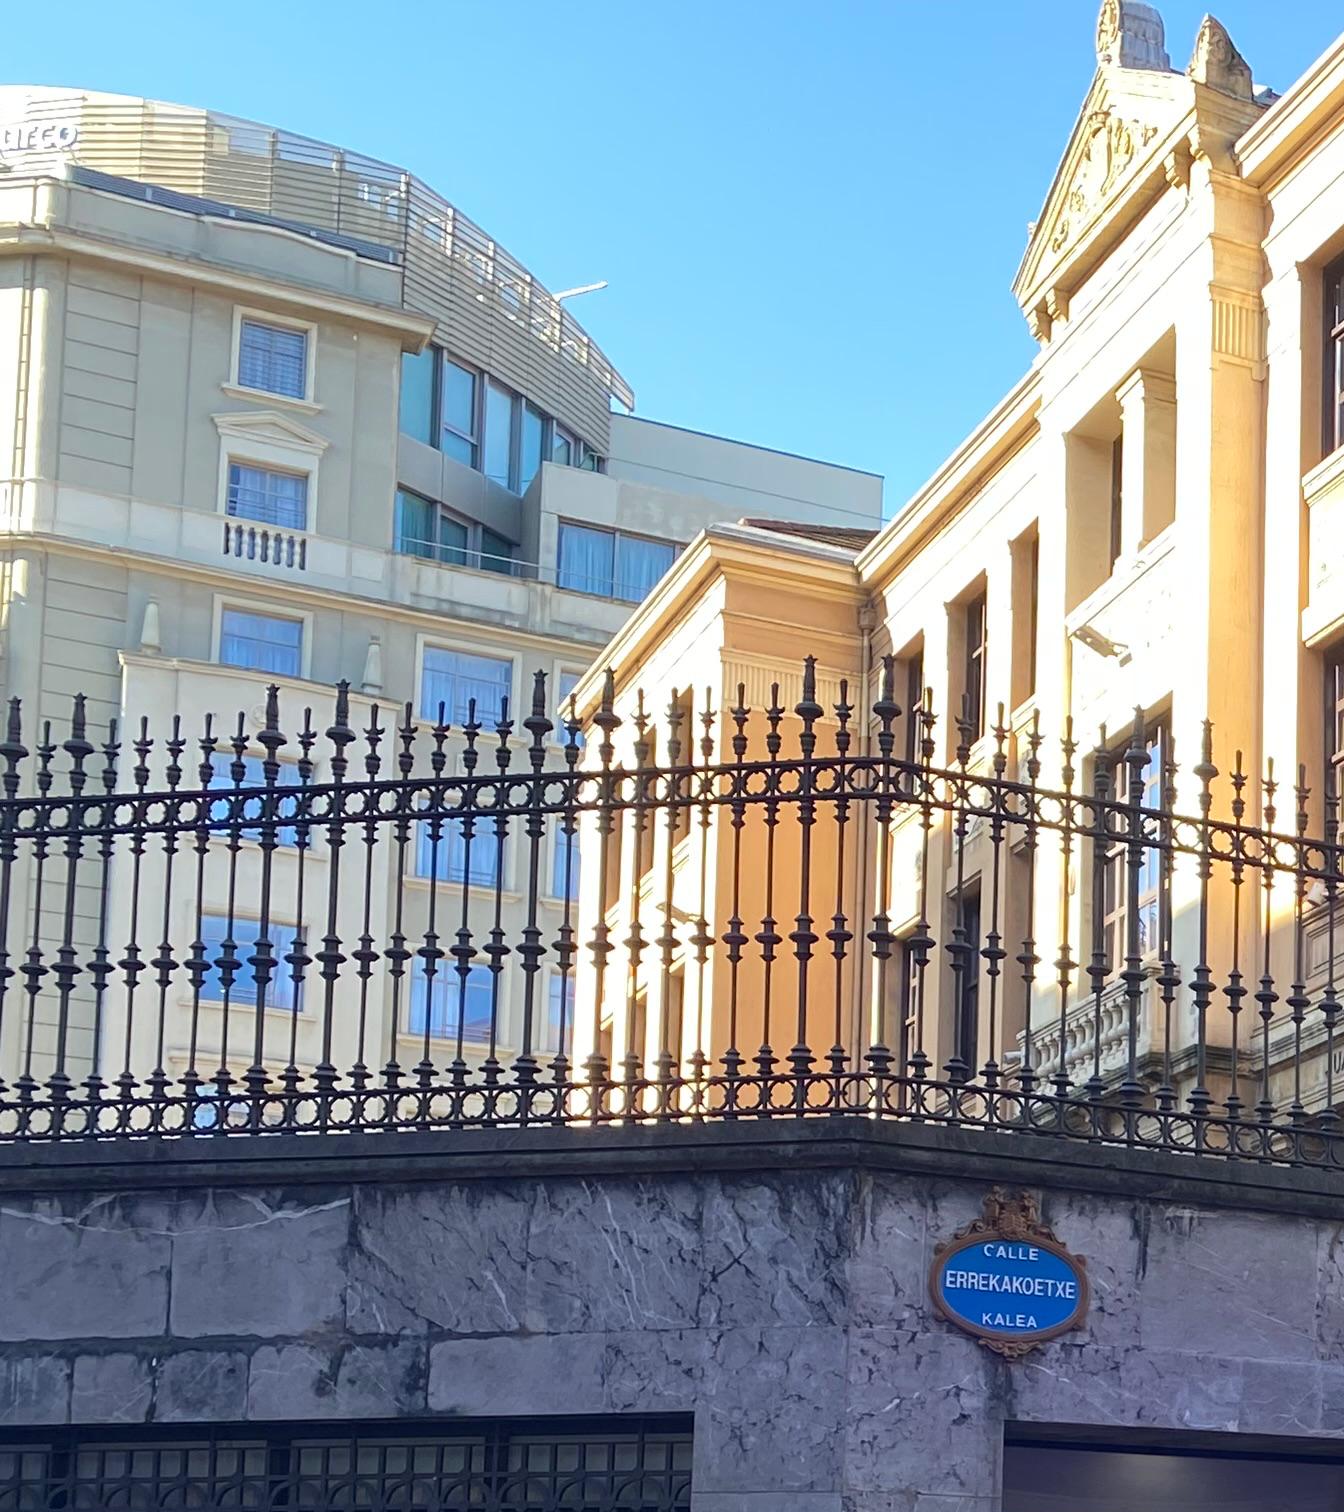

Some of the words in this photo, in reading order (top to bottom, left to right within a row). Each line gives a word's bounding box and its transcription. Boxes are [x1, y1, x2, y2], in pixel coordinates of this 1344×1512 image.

[983, 1244, 1039, 1261] CALLE
[945, 1270, 1076, 1299] ERREKAKOETXE
[982, 1312, 1038, 1328] KALEA
